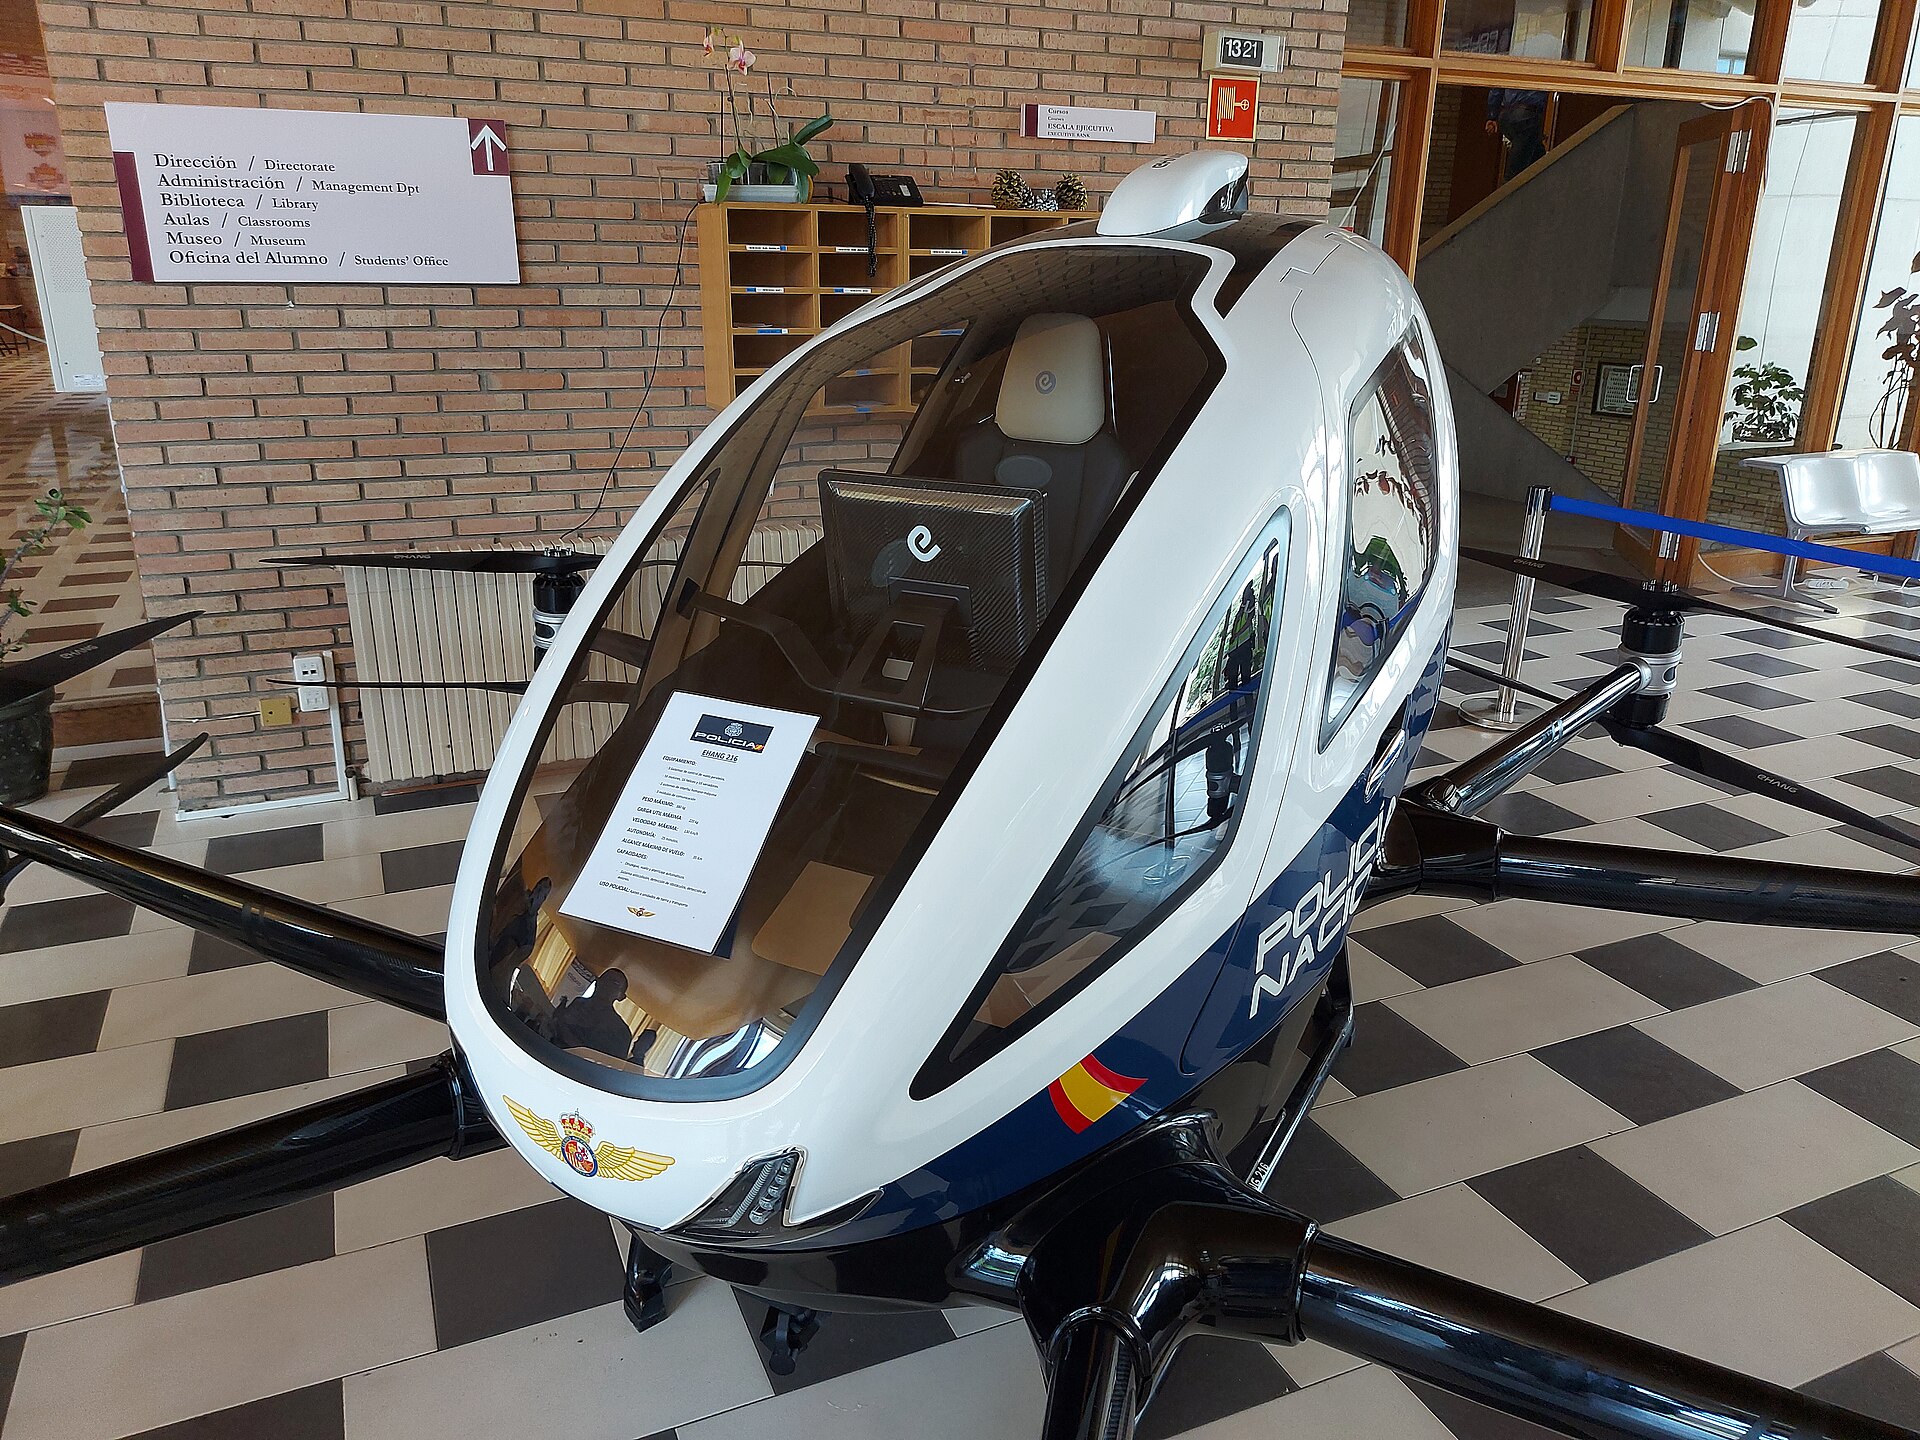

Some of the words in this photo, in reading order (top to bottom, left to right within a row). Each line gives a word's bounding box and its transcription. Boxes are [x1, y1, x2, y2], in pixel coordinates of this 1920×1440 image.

[1047, 107, 1069, 115] Cursos
[1047, 123, 1075, 131] ESCALA
[1076, 124, 1114, 133] EJECUTIVA
[154, 152, 237, 170] Dirección
[264, 159, 336, 173] Directorate
[157, 174, 286, 191] Administración
[312, 179, 394, 196] Management
[396, 182, 420, 197] Dpt
[160, 194, 245, 209] Biblioteca
[272, 198, 319, 212] Library
[163, 213, 210, 227] Aulas
[237, 215, 311, 229] Classrooms
[165, 231, 223, 246] Museo
[250, 235, 306, 246] Museum
[169, 250, 232, 266] Oficina
[235, 251, 261, 265] del
[265, 251, 328, 266] Alumno
[354, 255, 410, 267] Students'
[412, 255, 449, 267] Office
[702, 749, 725, 760] EHANG
[726, 754, 739, 762] 216
